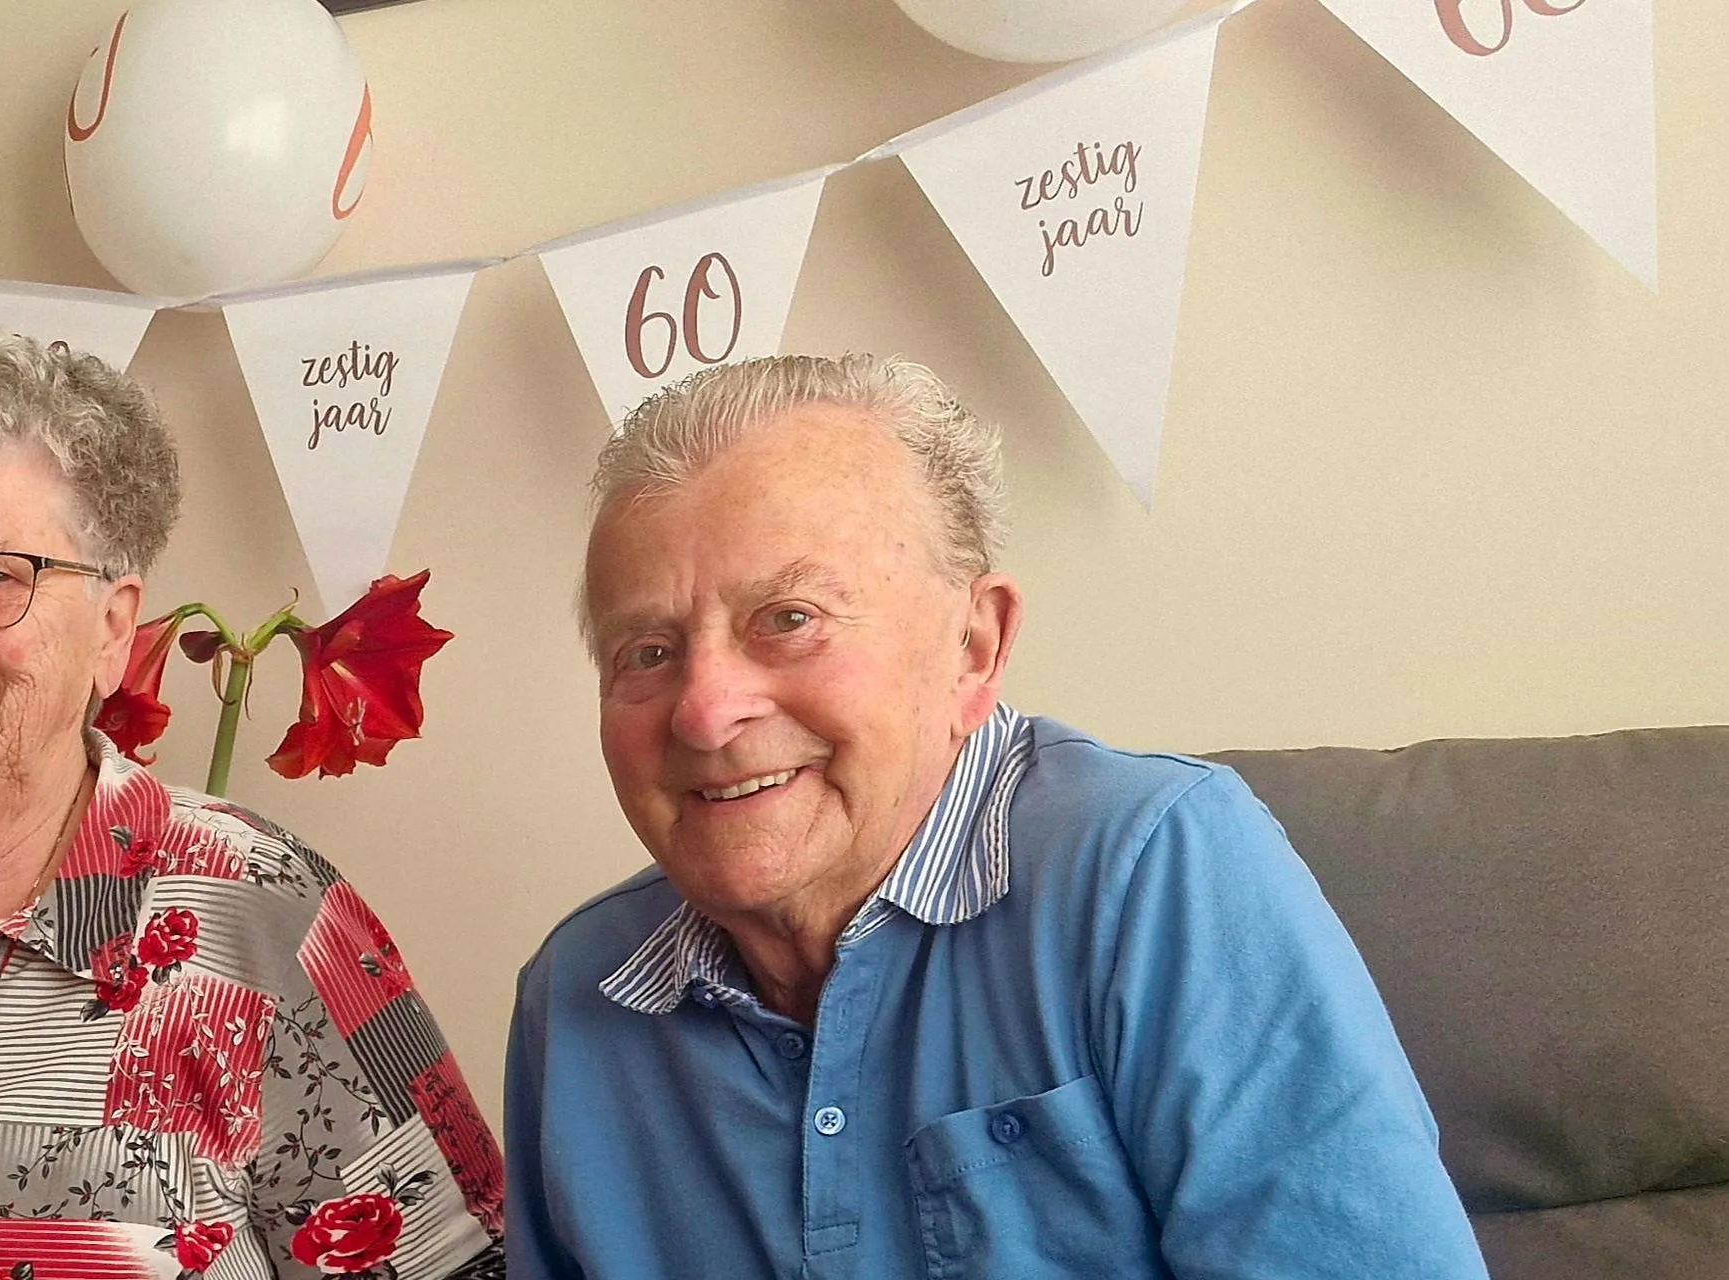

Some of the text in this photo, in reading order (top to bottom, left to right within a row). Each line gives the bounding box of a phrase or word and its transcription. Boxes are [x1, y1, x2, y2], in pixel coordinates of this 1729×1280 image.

[1014, 138, 1144, 212] zestig
[1038, 194, 1145, 279] jaar
[624, 251, 744, 380] 60
[300, 338, 401, 399] zestig
[307, 395, 394, 452] jaar
